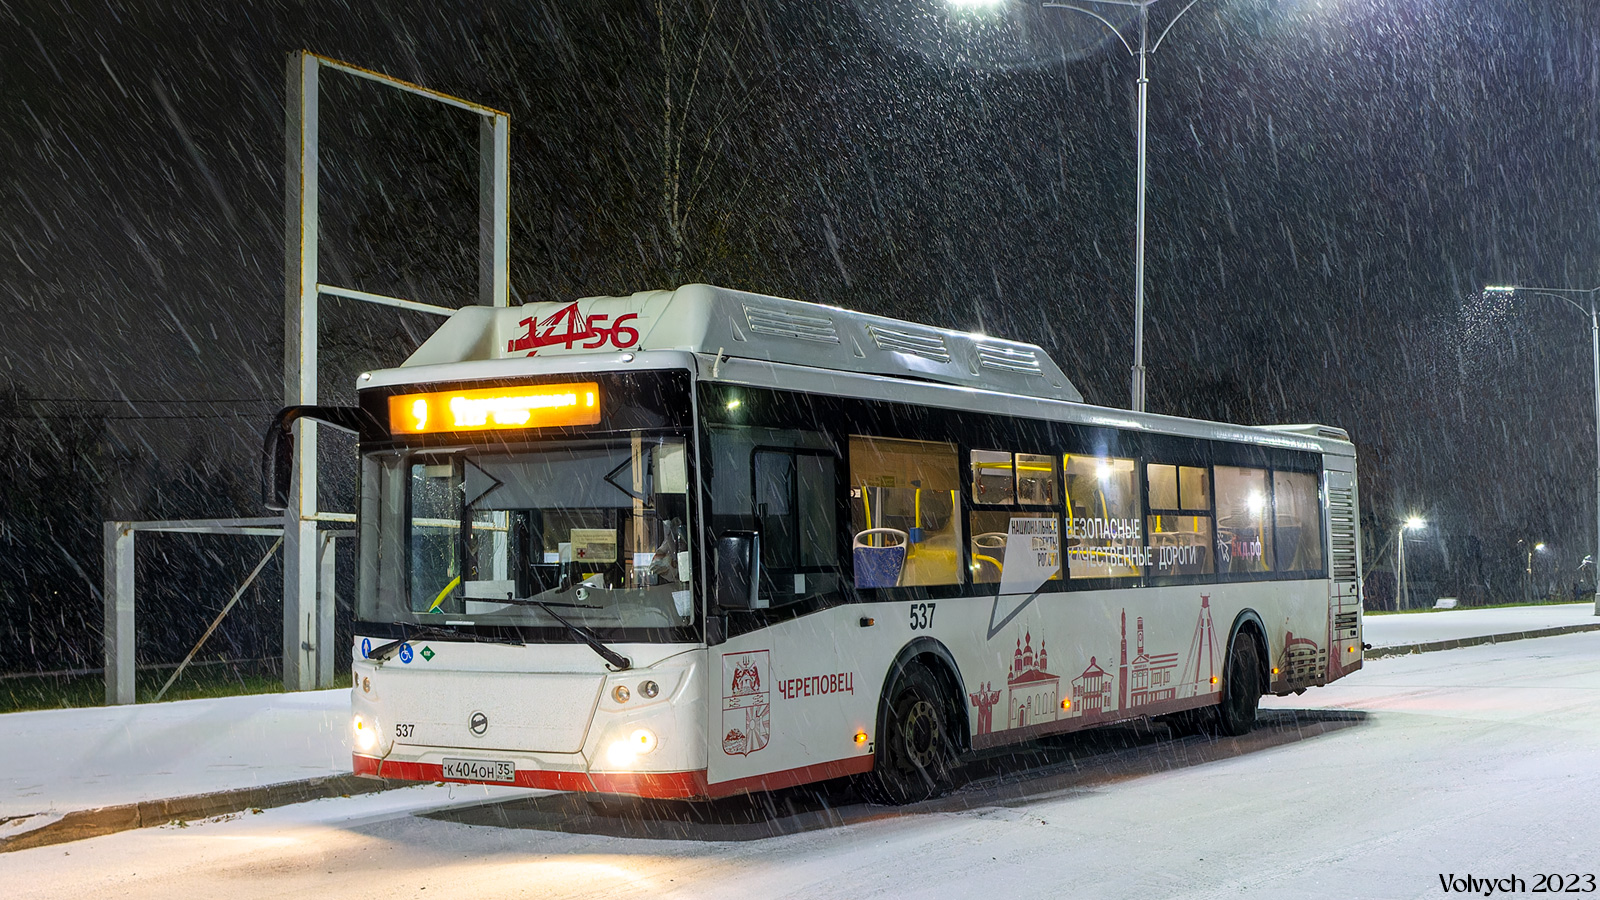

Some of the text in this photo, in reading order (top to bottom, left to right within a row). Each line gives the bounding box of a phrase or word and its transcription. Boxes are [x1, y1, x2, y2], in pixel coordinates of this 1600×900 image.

[1065, 517, 1141, 539] БЕЗОПАСНЫЕ
[1067, 545, 1197, 570] КАЧЕСТВЕННЫЕ ДОРОГИ
[909, 602, 936, 631] 537
[778, 671, 854, 700] ЧЕРЕПОВЕЦ
[395, 723, 415, 739] 537
[497, 763, 510, 776] 35
